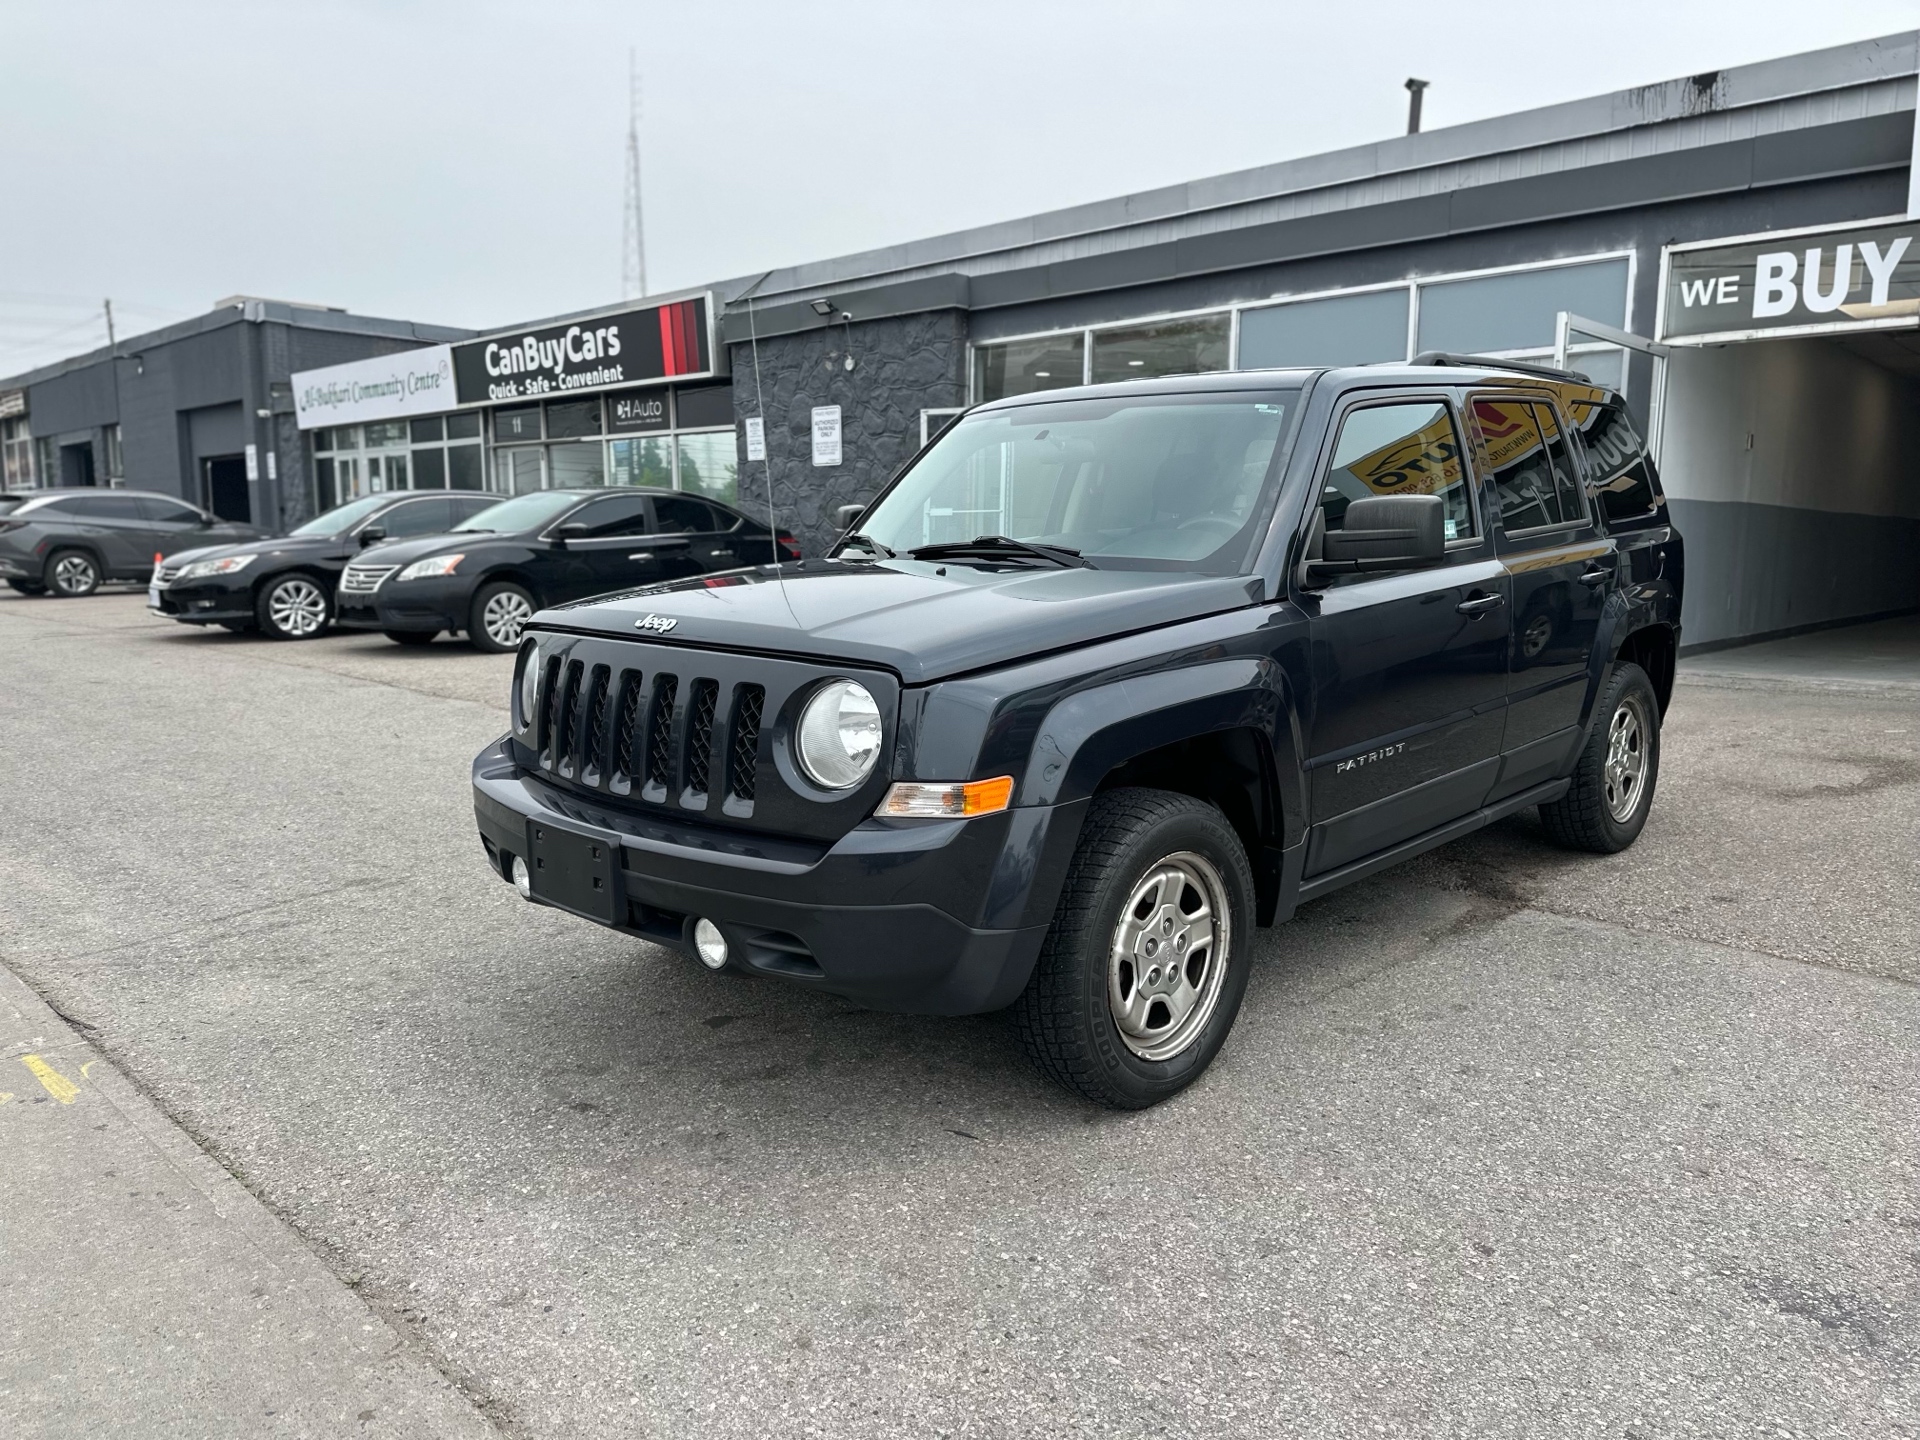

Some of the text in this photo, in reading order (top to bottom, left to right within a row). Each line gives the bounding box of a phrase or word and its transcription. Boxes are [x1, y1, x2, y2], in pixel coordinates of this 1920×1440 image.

[1681, 236, 1913, 319] WE BUY
[485, 325, 622, 377] CanBuyCars
[352, 374, 406, 402] Community
[407, 371, 440, 395] Centre
[488, 380, 518, 400] Quick
[525, 375, 550, 395] Safe
[558, 363, 624, 390] Convenient
[632, 399, 663, 417] Auto
[512, 416, 521, 434] 11
[634, 613, 677, 635] Jeep
[1336, 743, 1406, 774] PATRIOT
[1092, 955, 1120, 1072] COOPER
